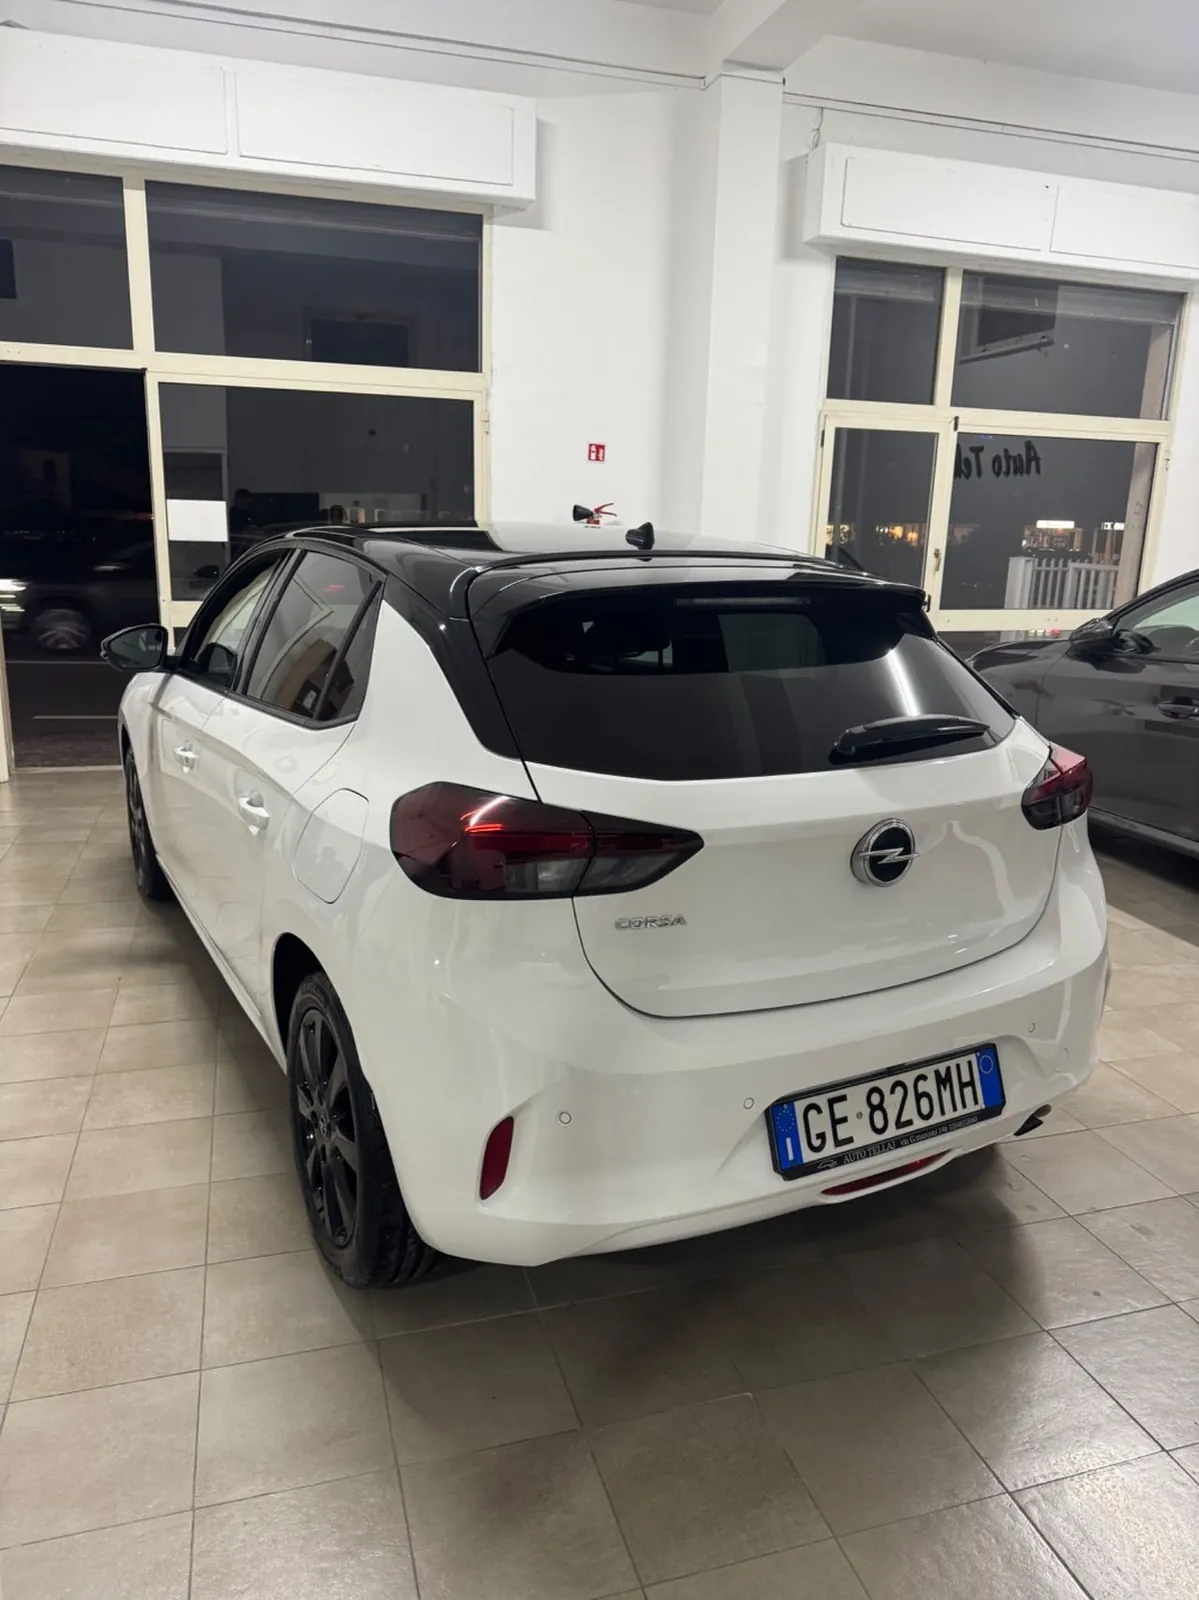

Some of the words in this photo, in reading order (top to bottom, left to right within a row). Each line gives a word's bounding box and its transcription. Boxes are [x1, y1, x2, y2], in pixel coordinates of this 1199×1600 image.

[614, 914, 687, 931] CORSA
[802, 1094, 855, 1153] GE
[866, 1060, 979, 1135] 826MH
[843, 1148, 867, 1164] AUTO
